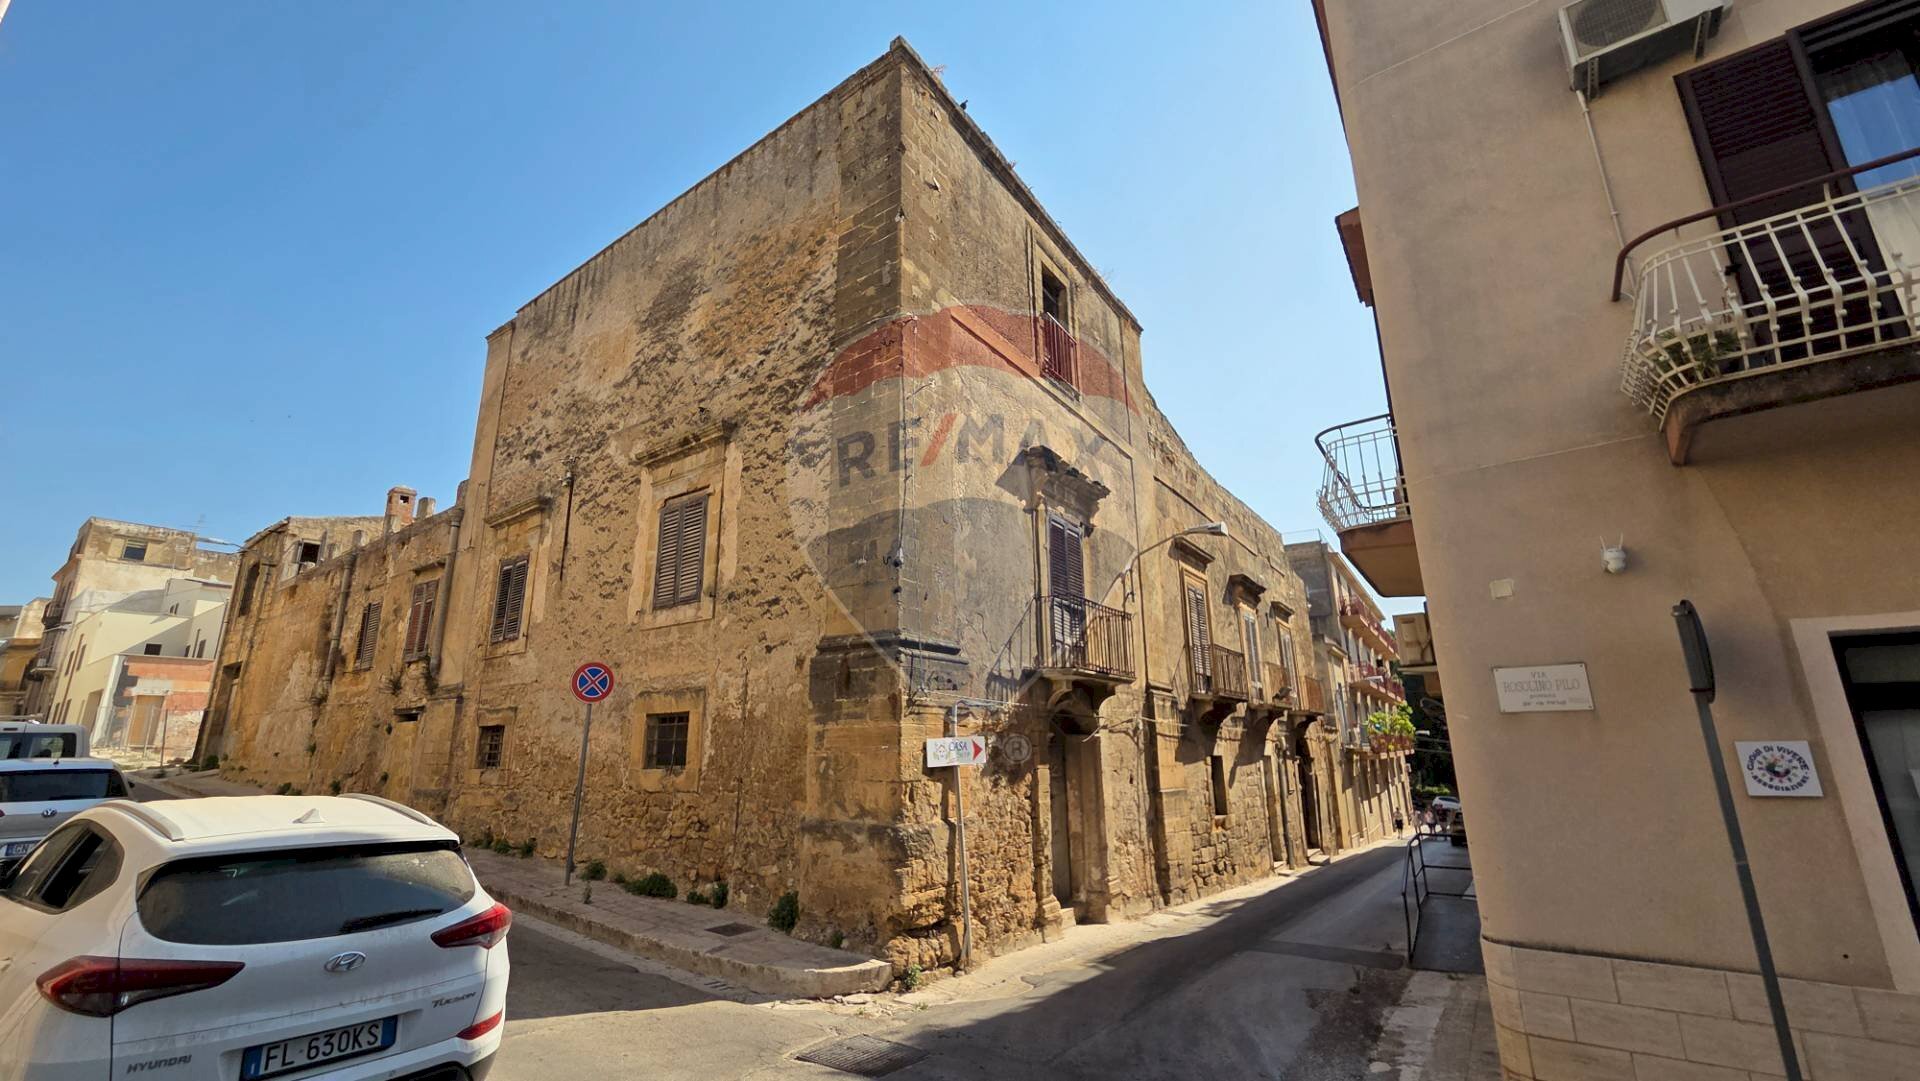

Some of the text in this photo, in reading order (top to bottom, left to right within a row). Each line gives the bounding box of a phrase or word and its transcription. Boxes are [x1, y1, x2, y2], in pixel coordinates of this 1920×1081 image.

[1530, 671, 1547, 679] VIA
[1503, 678, 1581, 693] ROSOLINO PILO
[949, 741, 968, 752] CASA
[264, 1023, 380, 1071] FL 630KS
[126, 1054, 193, 1074] HYUNDAI
